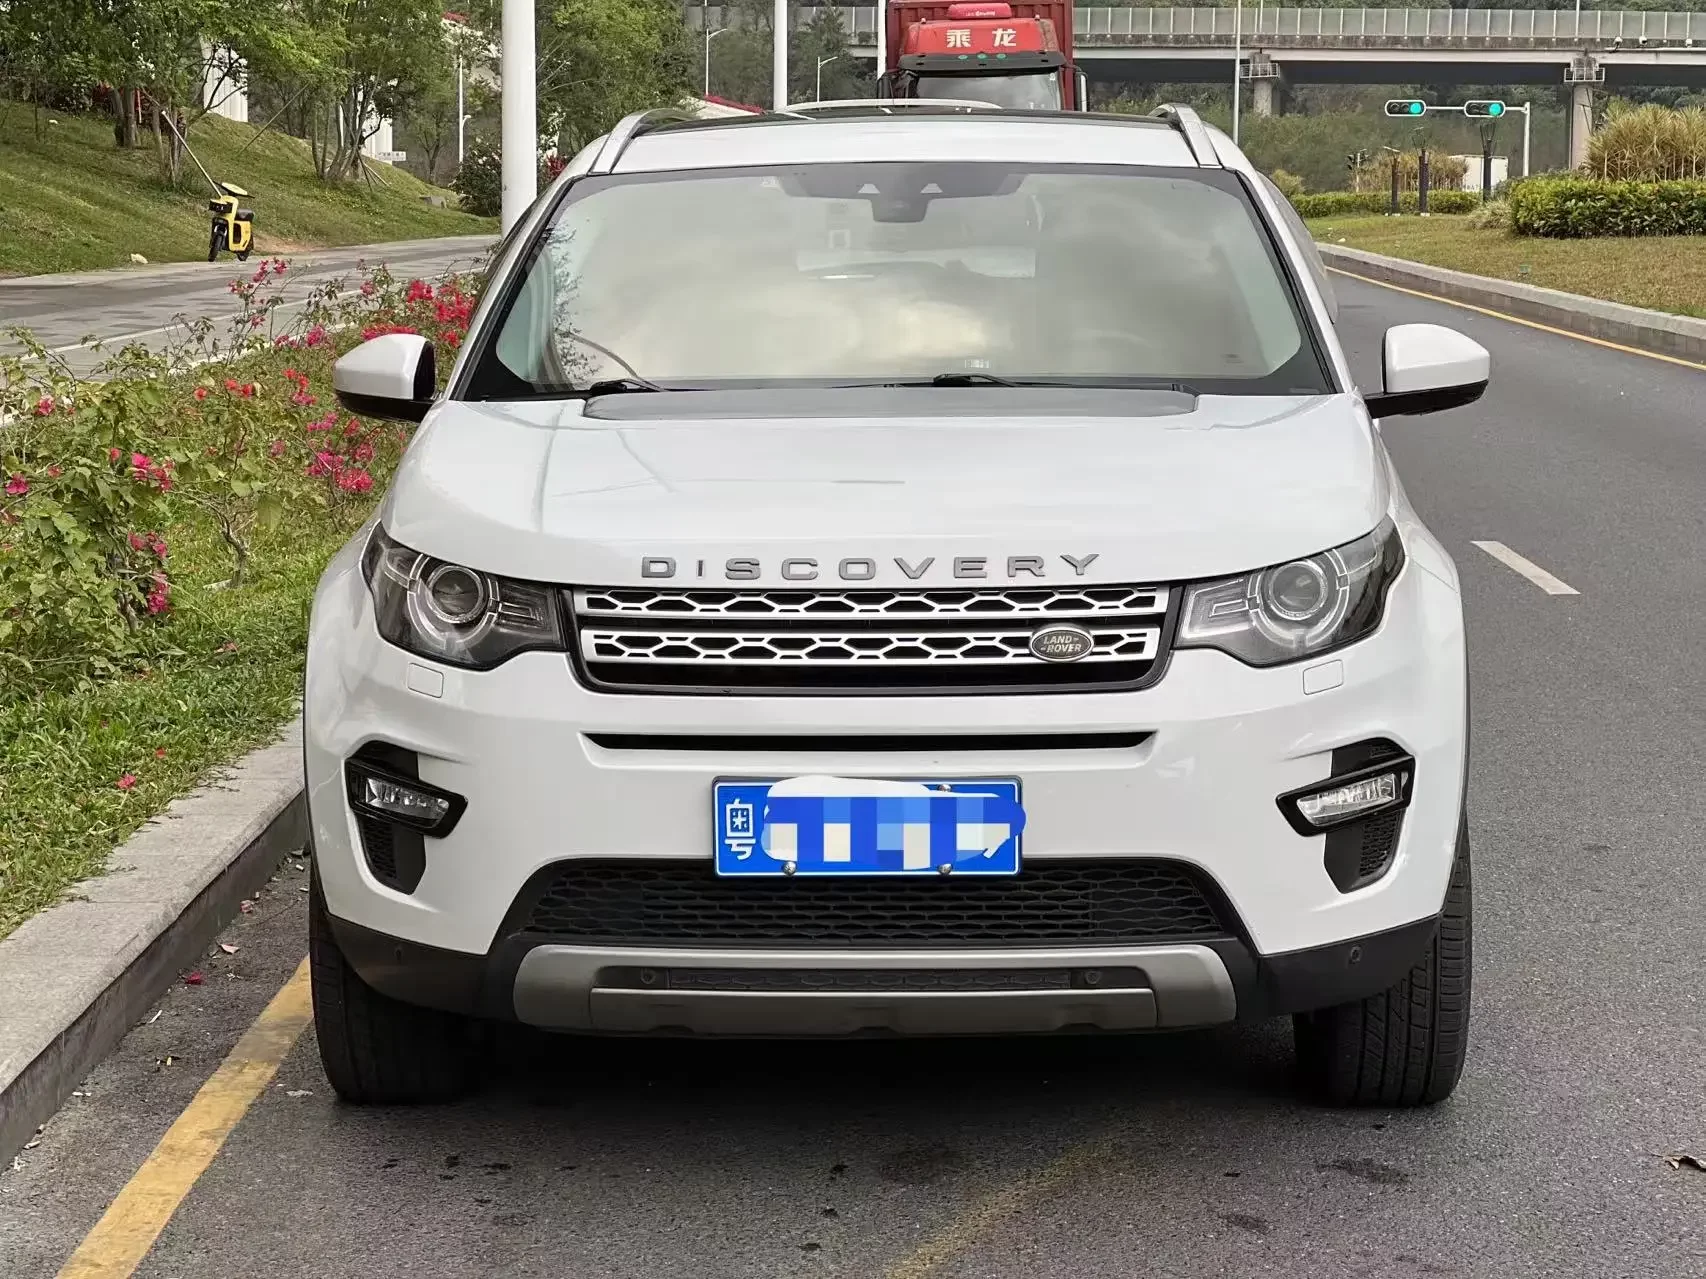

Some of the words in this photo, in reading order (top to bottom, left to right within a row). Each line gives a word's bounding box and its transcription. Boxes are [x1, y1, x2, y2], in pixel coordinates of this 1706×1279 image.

[946, 28, 1017, 48] 乘龙
[641, 553, 1100, 580] DISCOVERY
[1043, 635, 1074, 645] LAND
[1046, 643, 1082, 653] ROVER
[724, 798, 756, 861] 粤
